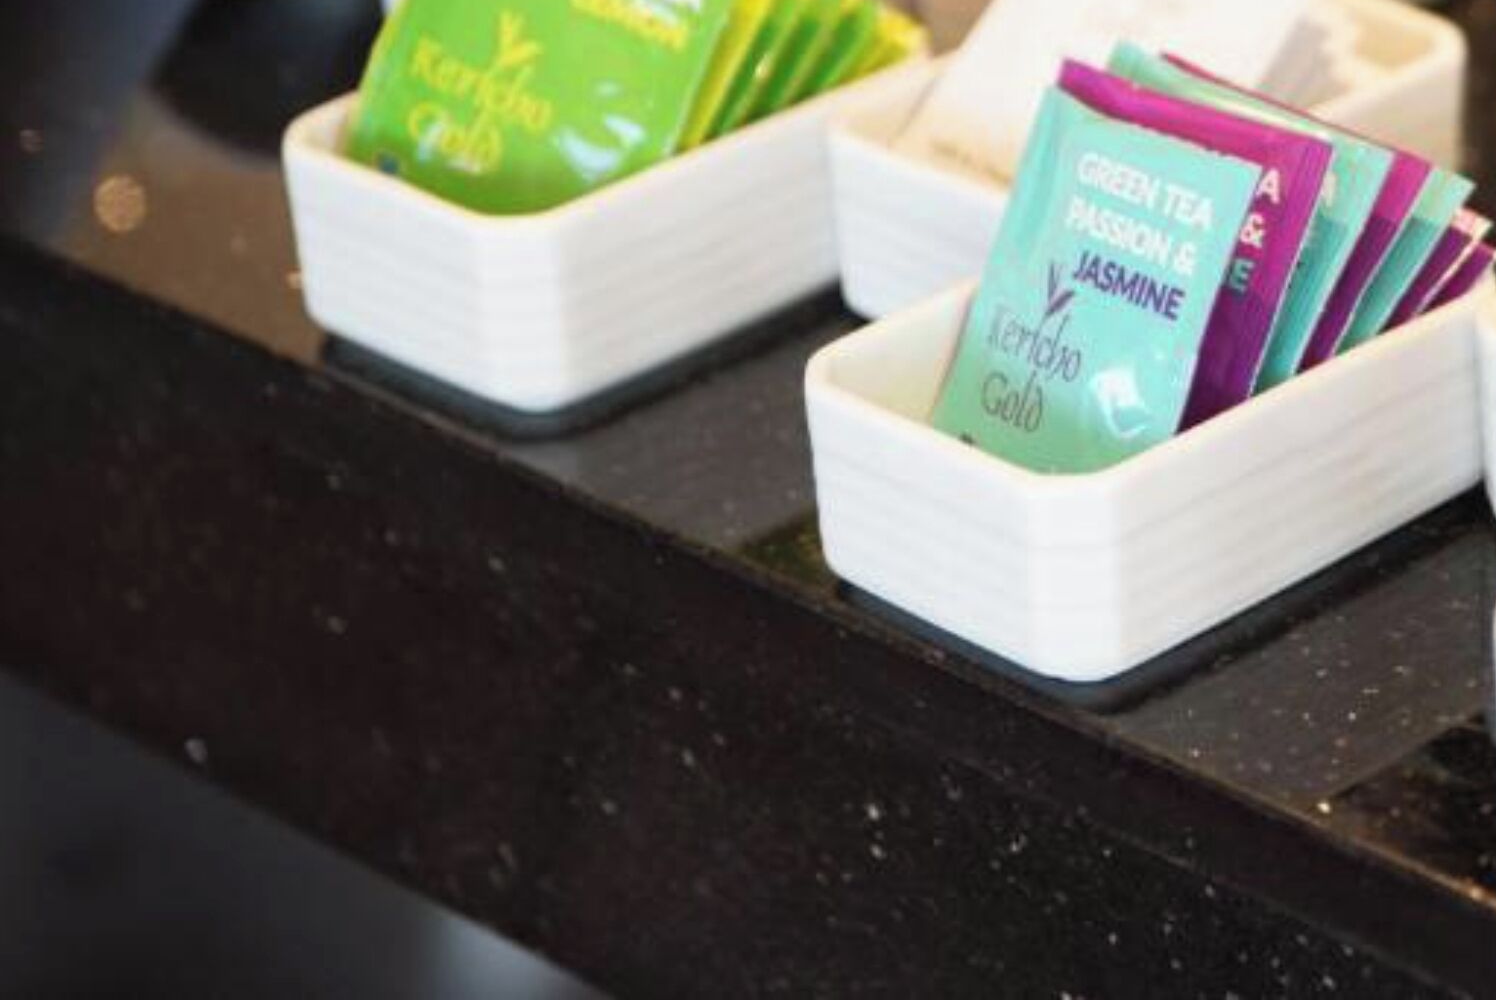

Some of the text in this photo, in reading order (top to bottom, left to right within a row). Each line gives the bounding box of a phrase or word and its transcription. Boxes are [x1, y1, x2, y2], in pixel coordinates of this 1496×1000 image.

[1076, 151, 1160, 210] GREEN
[1162, 184, 1216, 231] TEA
[1064, 196, 1174, 265] PASSION
[1176, 241, 1199, 277] &
[1070, 250, 1188, 322] JASMINE
[986, 306, 1083, 382] Kericho
[979, 371, 1044, 434] Gold
